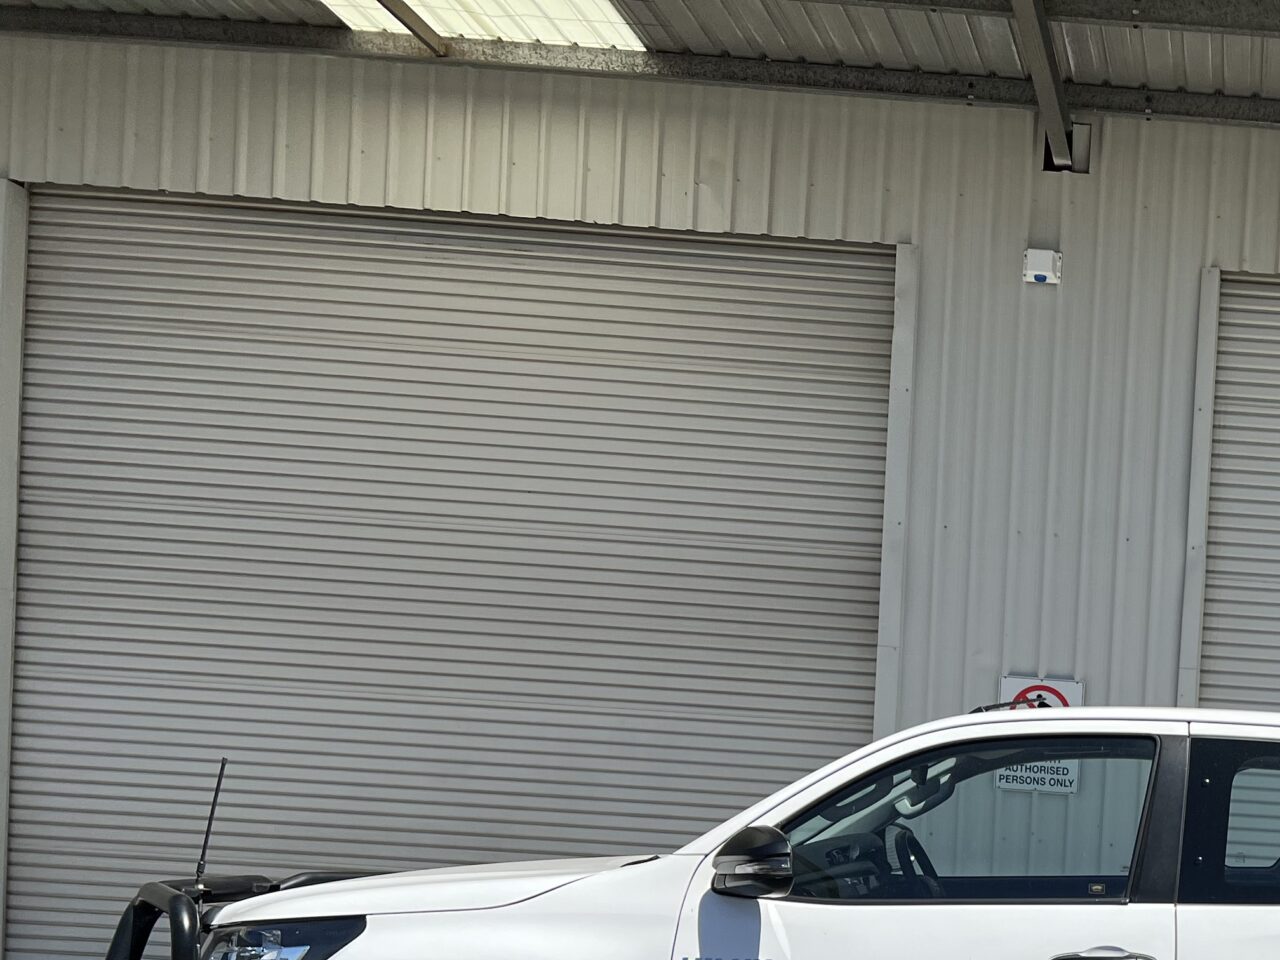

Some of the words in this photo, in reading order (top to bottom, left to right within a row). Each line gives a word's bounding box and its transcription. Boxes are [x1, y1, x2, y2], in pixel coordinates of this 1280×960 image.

[1004, 764, 1069, 776] AUTHORISED
[998, 774, 1046, 786] PERSONS
[1048, 778, 1075, 788] ONLY
